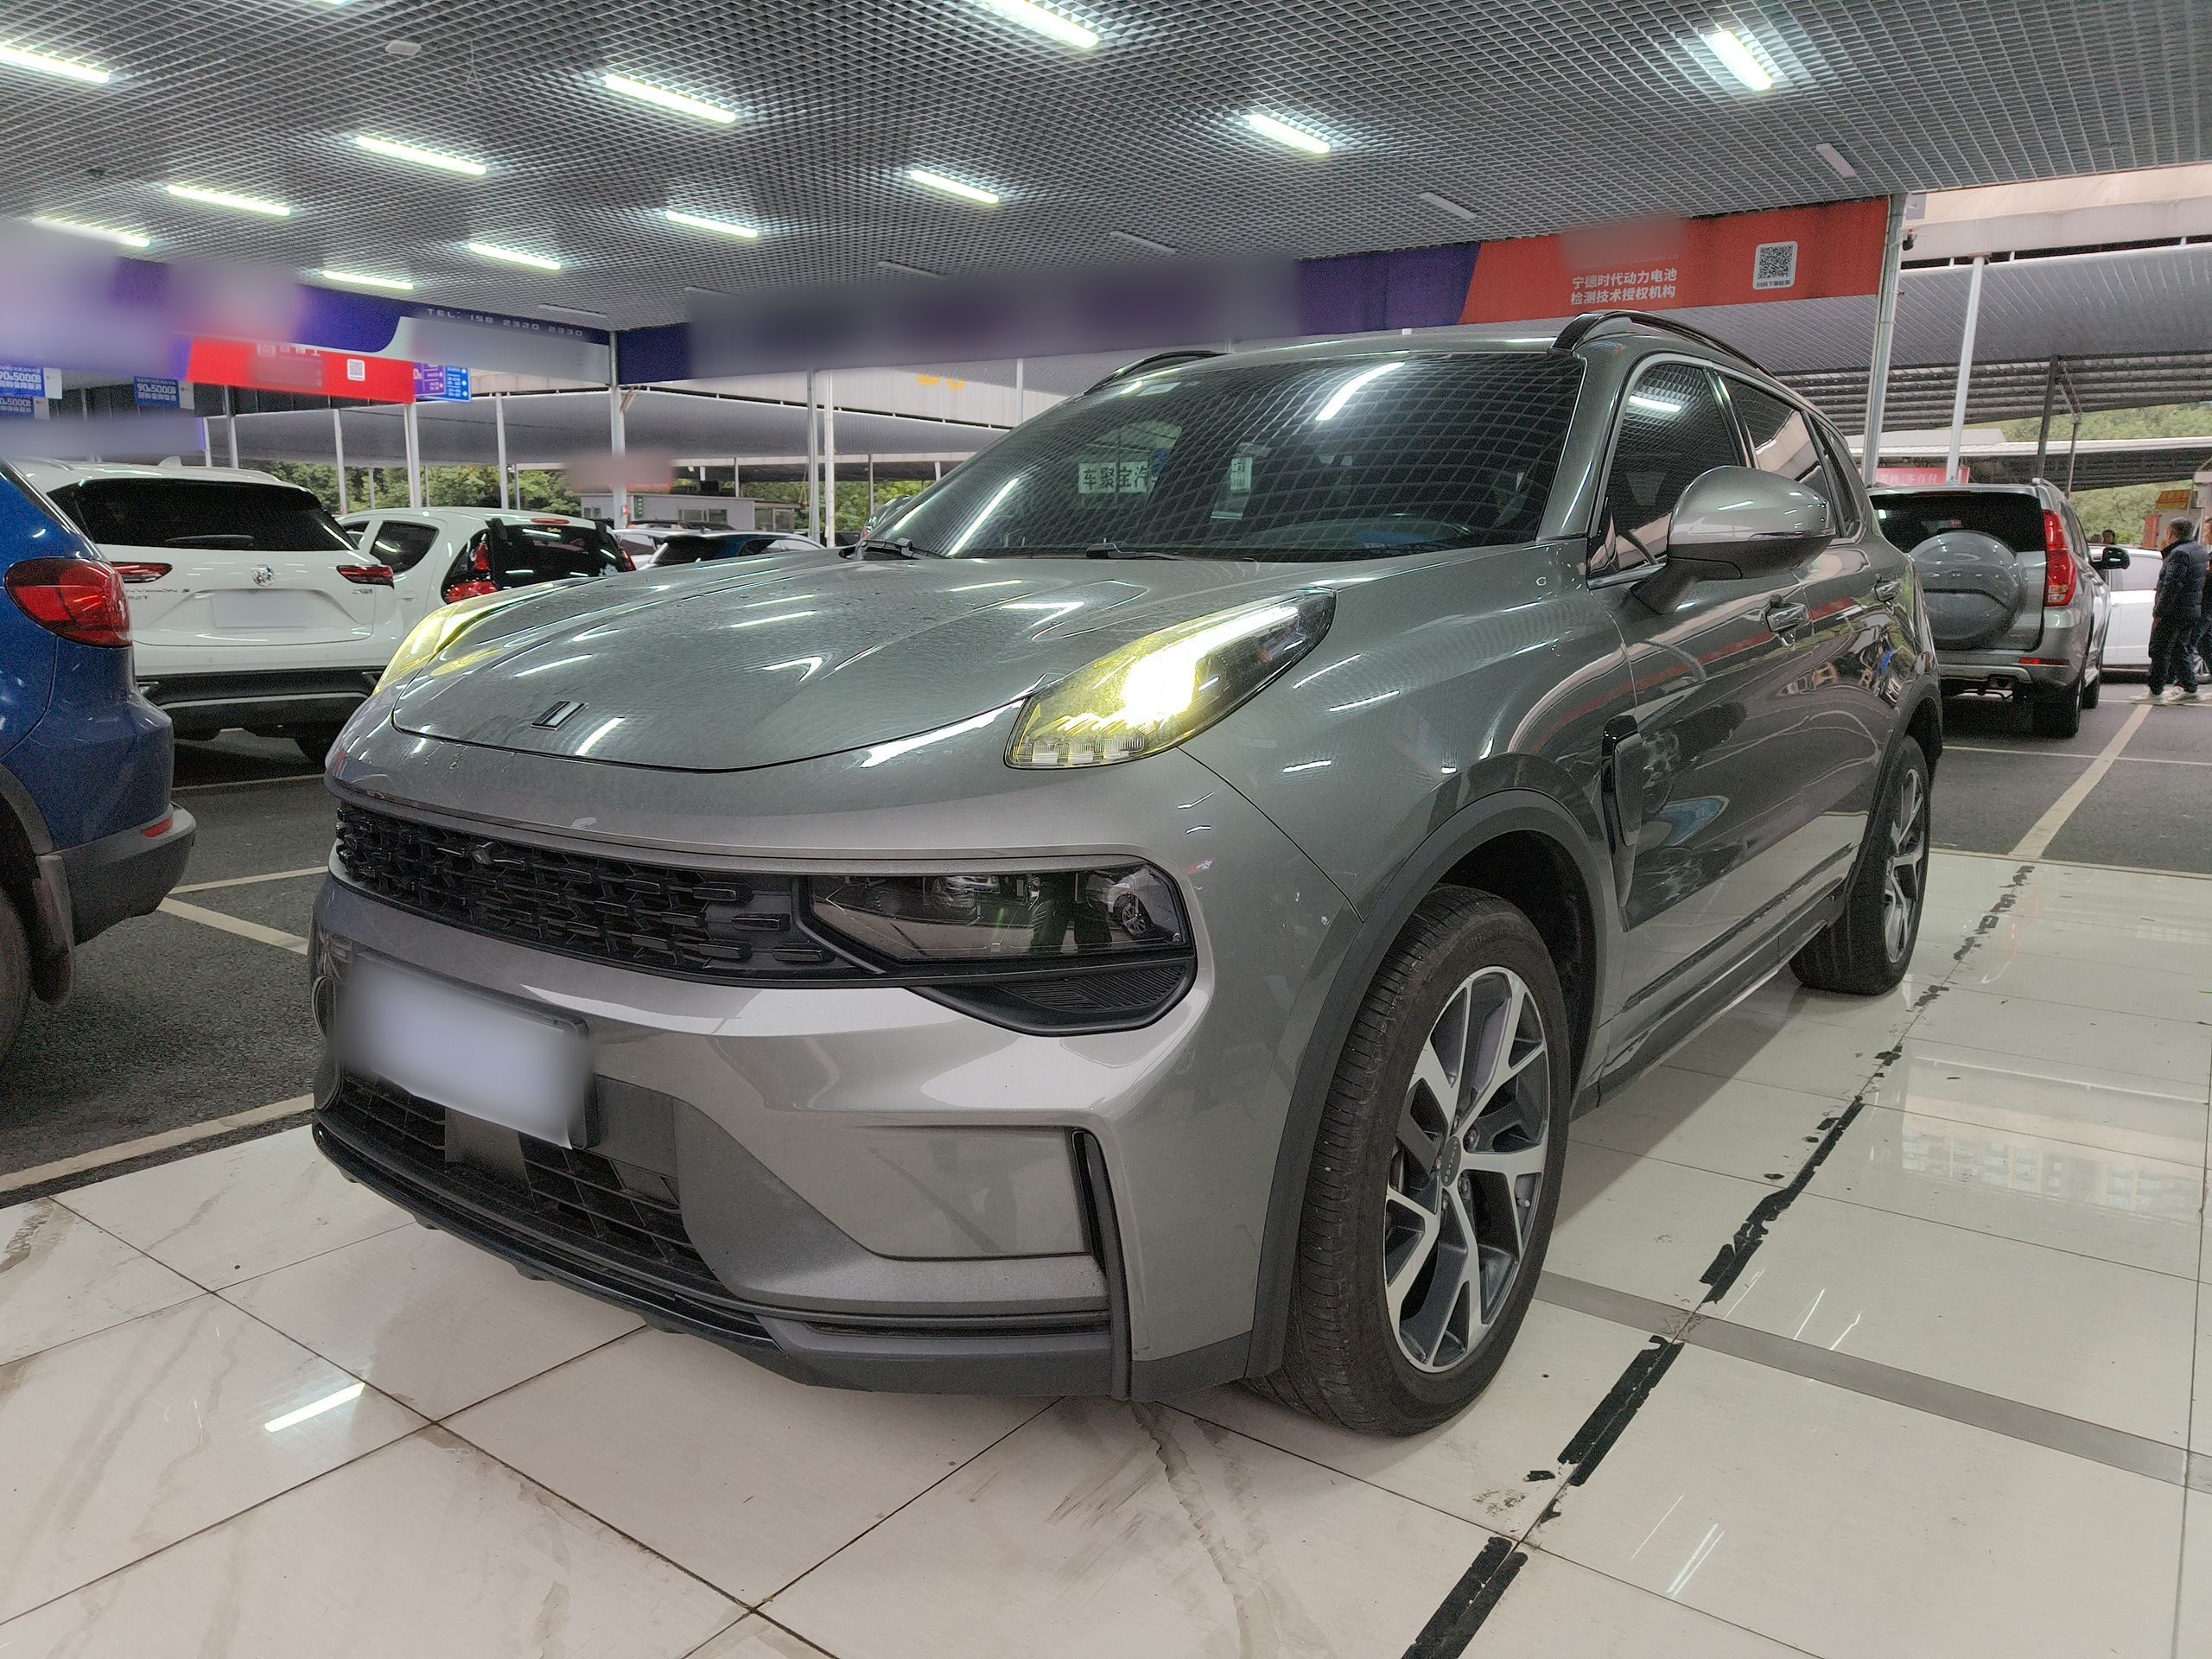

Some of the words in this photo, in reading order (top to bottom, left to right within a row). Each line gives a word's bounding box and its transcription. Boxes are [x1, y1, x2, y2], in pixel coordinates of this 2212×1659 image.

[1573, 267, 1678, 290] 宁德时代动力电池
[1571, 283, 1676, 305] 检测技术授权机构
[470, 315, 493, 324] 158
[503, 319, 540, 330] 2320
[548, 326, 583, 336] 2330
